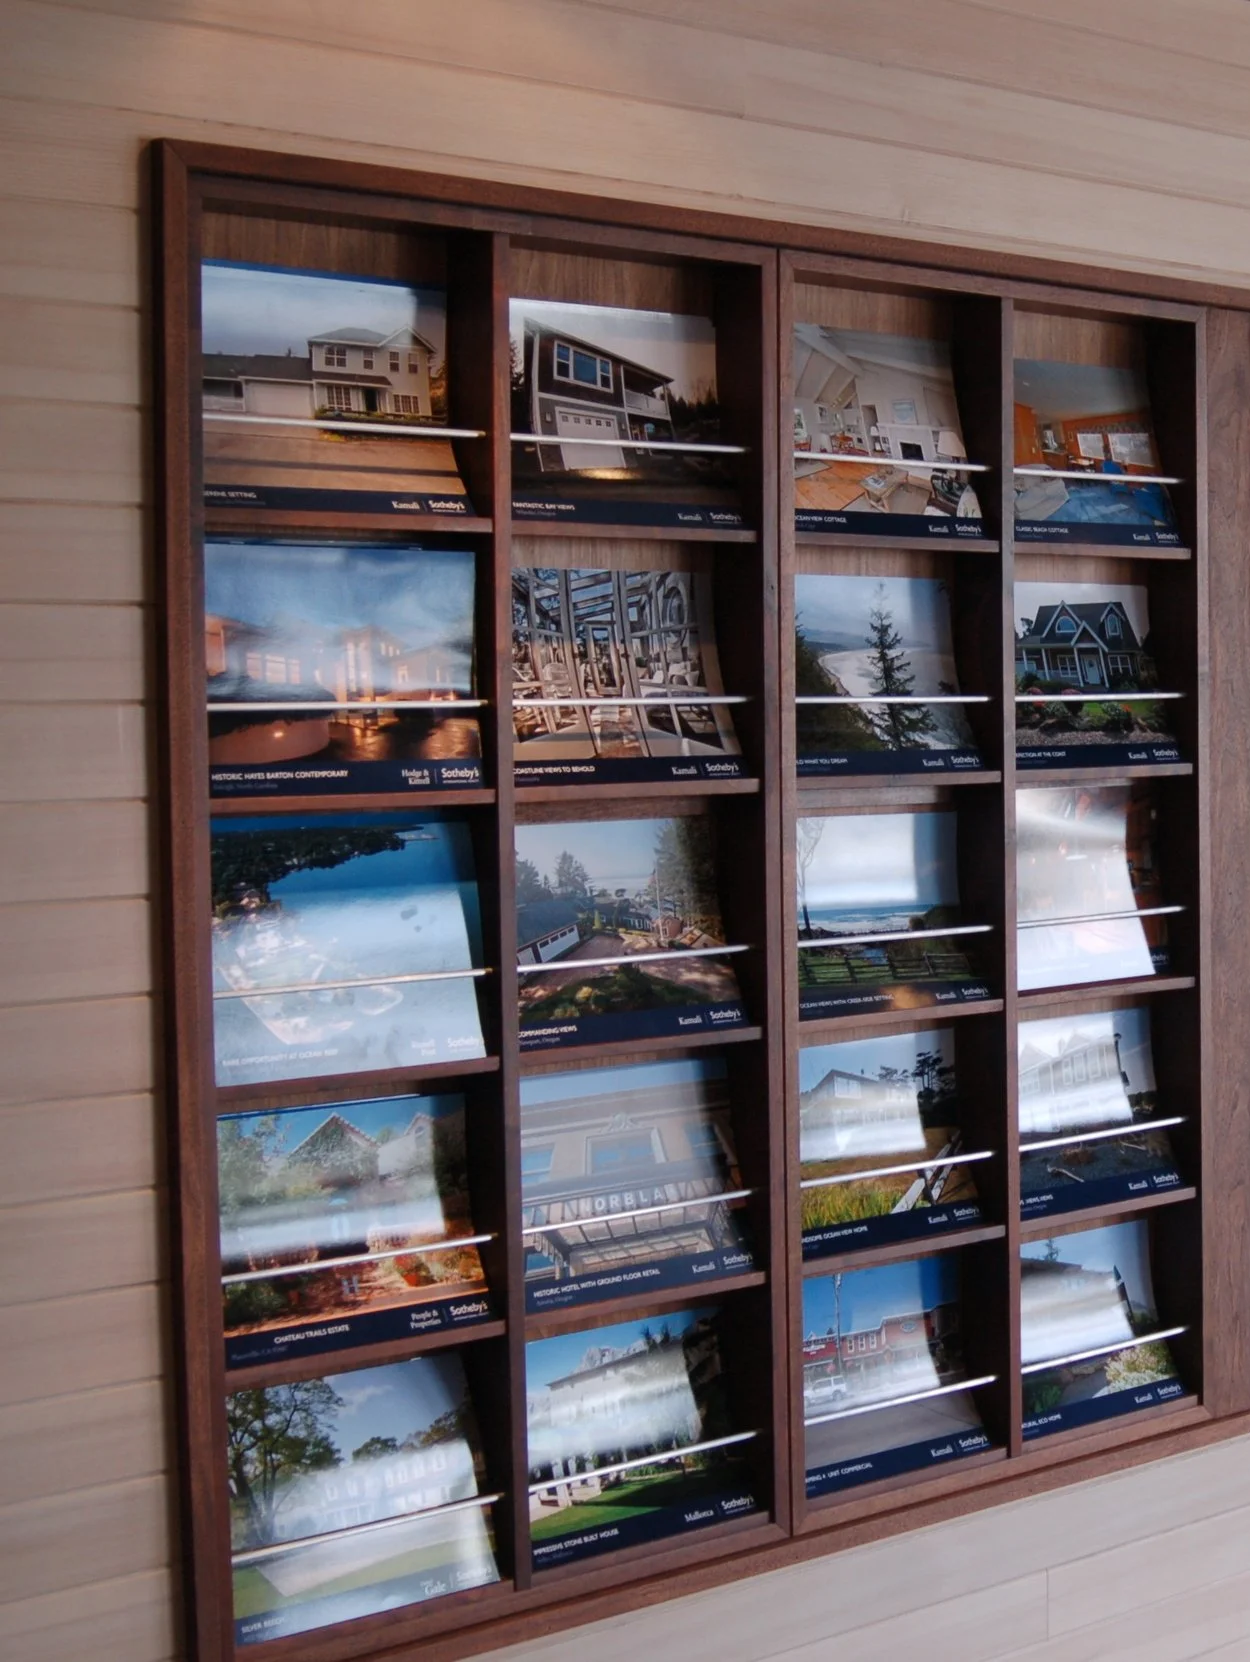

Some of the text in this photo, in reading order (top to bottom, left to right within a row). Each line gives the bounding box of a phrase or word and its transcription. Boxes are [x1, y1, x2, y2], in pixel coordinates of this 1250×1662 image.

[441, 767, 479, 780] Sotheby's
[706, 762, 739, 775] Sotheby's
[212, 773, 243, 781] HISTORIC
[266, 771, 293, 779] BARTON
[295, 770, 348, 779] CONTEMPORARY
[449, 1300, 488, 1316] Sotheby's
[274, 1324, 350, 1345] CHATEAU TRAILS ESTATE
